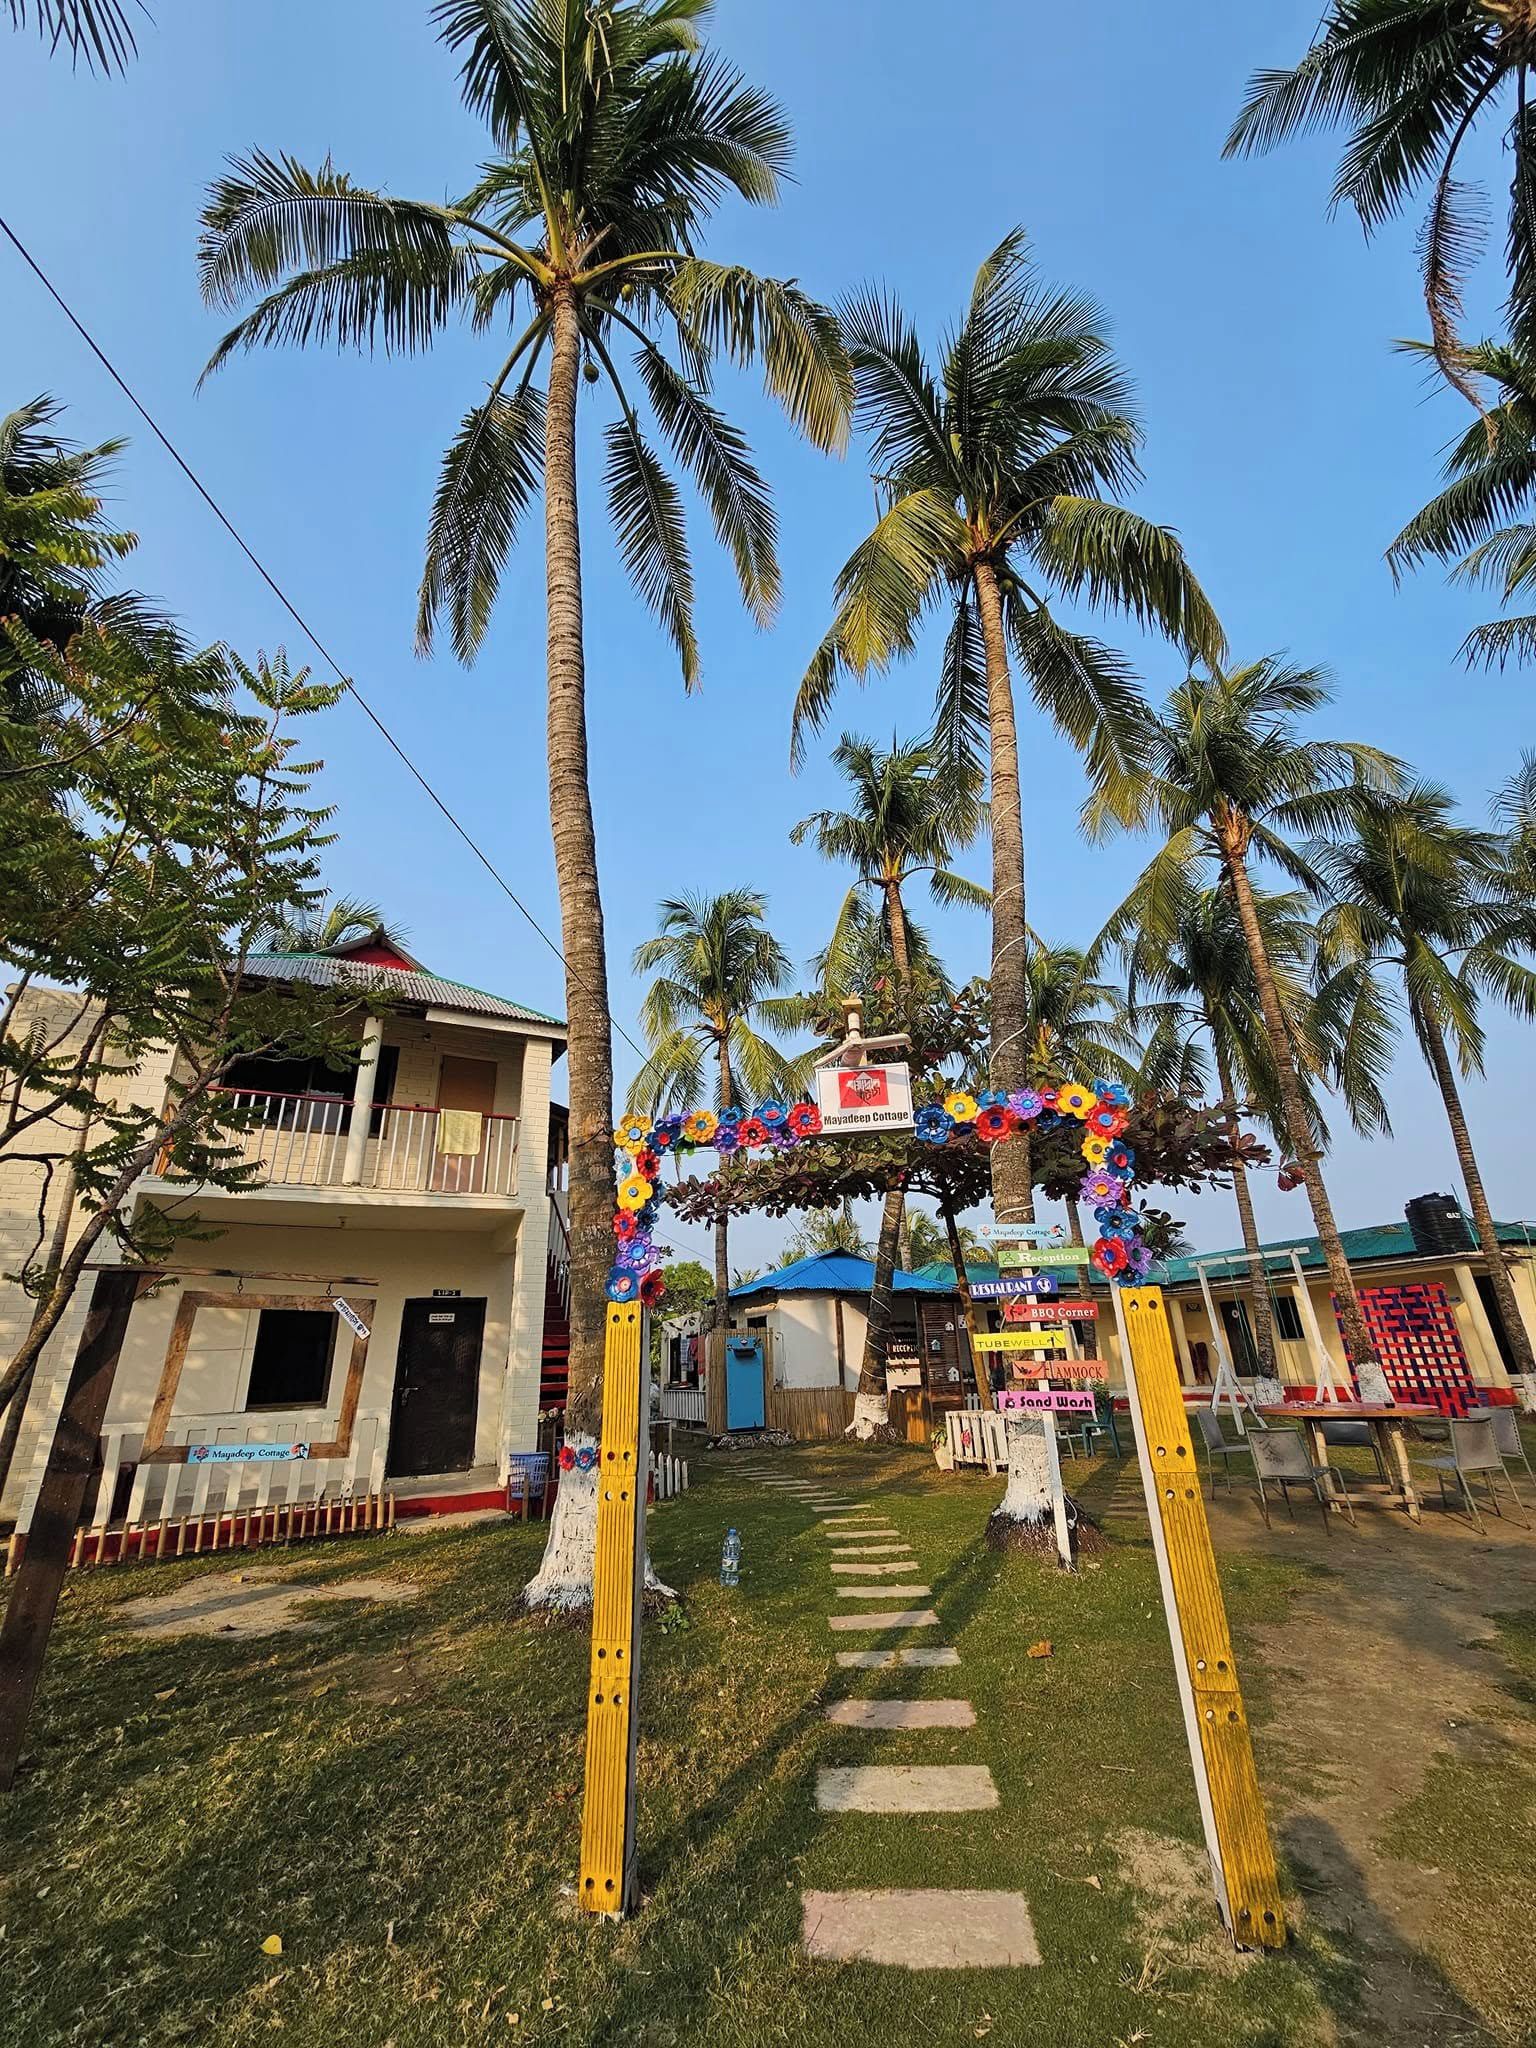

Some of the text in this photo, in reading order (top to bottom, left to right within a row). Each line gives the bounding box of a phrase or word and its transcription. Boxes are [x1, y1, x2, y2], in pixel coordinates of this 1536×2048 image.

[823, 1111, 909, 1126] Mayadeep Cottage
[1018, 1252, 1080, 1263] Reception
[972, 1281, 1033, 1295] RESTAURANT
[1031, 1307, 1095, 1318] BBQ Corner
[976, 1339, 1047, 1348] TUBEWELL
[1044, 1361, 1103, 1379] HAMMOCK
[1020, 1396, 1092, 1408] Sand Wash
[212, 1449, 290, 1460] Mayadeep Cottage
